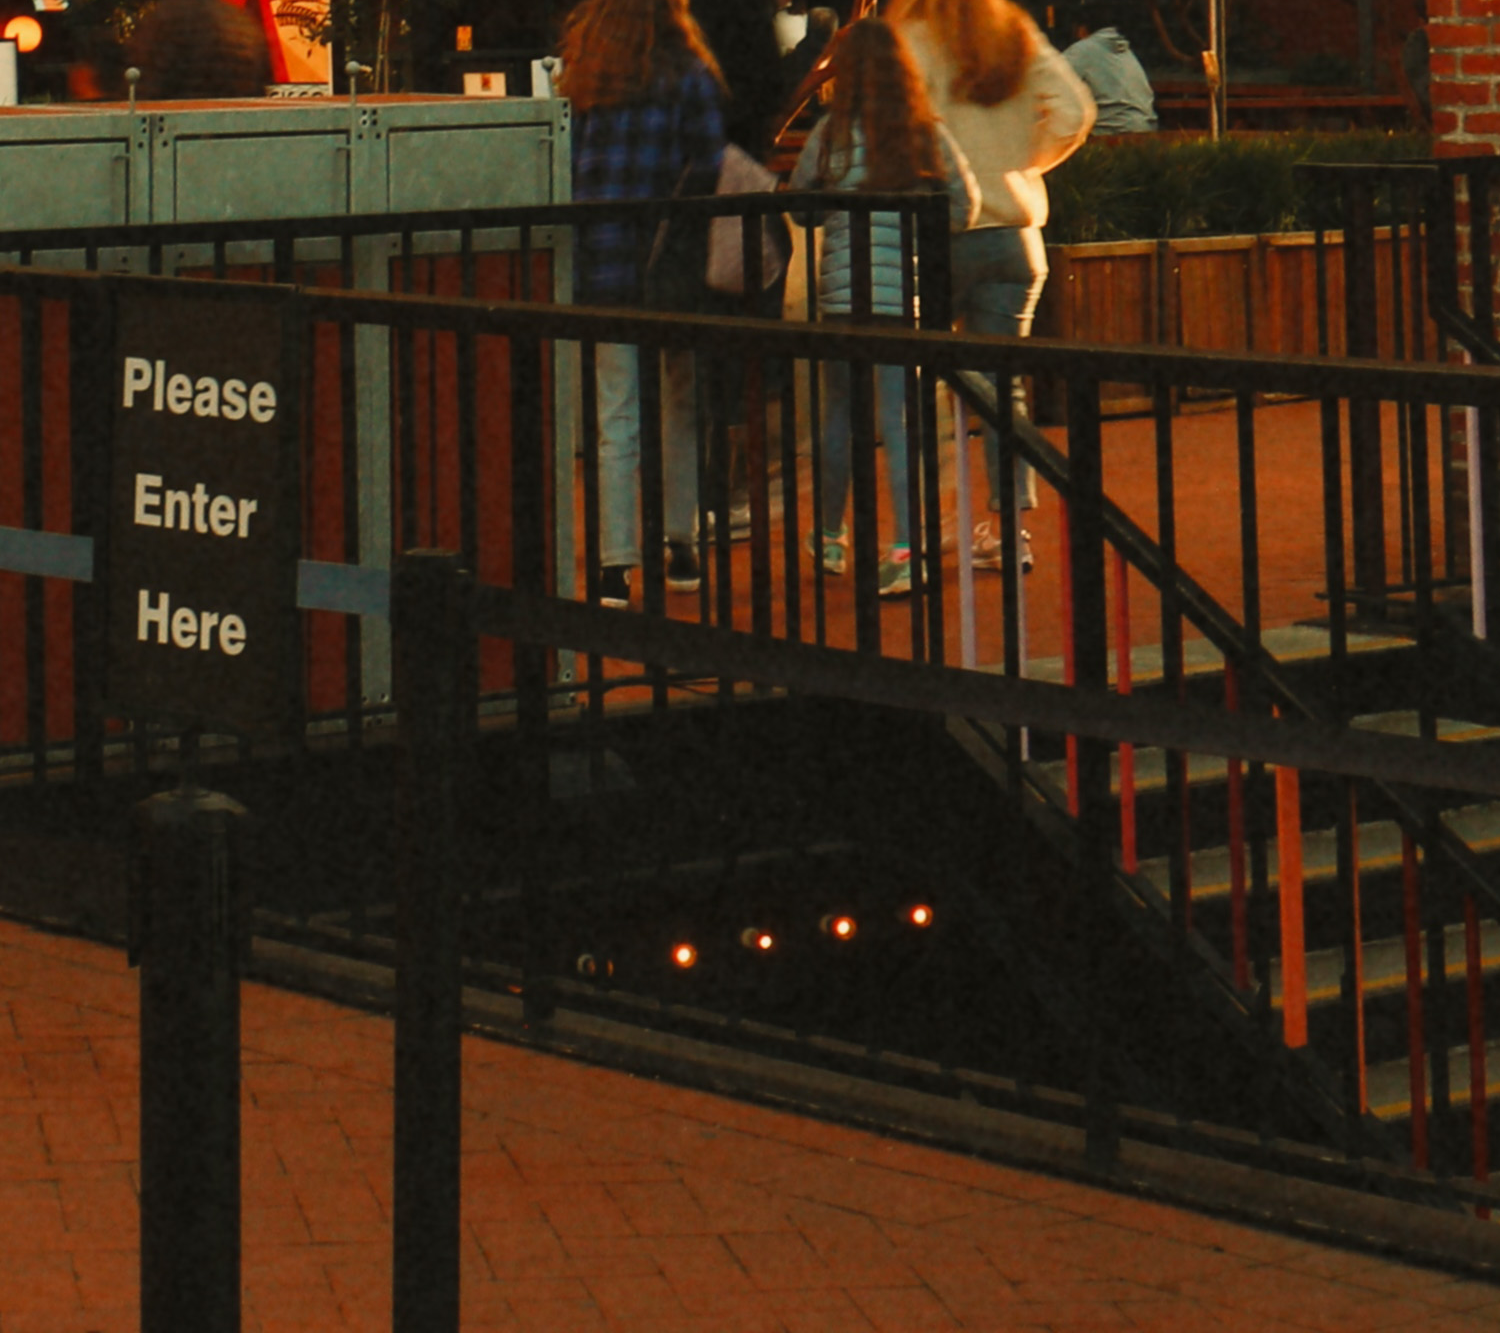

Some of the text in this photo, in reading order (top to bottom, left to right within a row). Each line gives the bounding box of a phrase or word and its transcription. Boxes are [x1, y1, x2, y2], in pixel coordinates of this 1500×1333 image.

[122, 356, 277, 423] Please
[134, 473, 258, 538] Enter
[137, 589, 246, 656] Here
